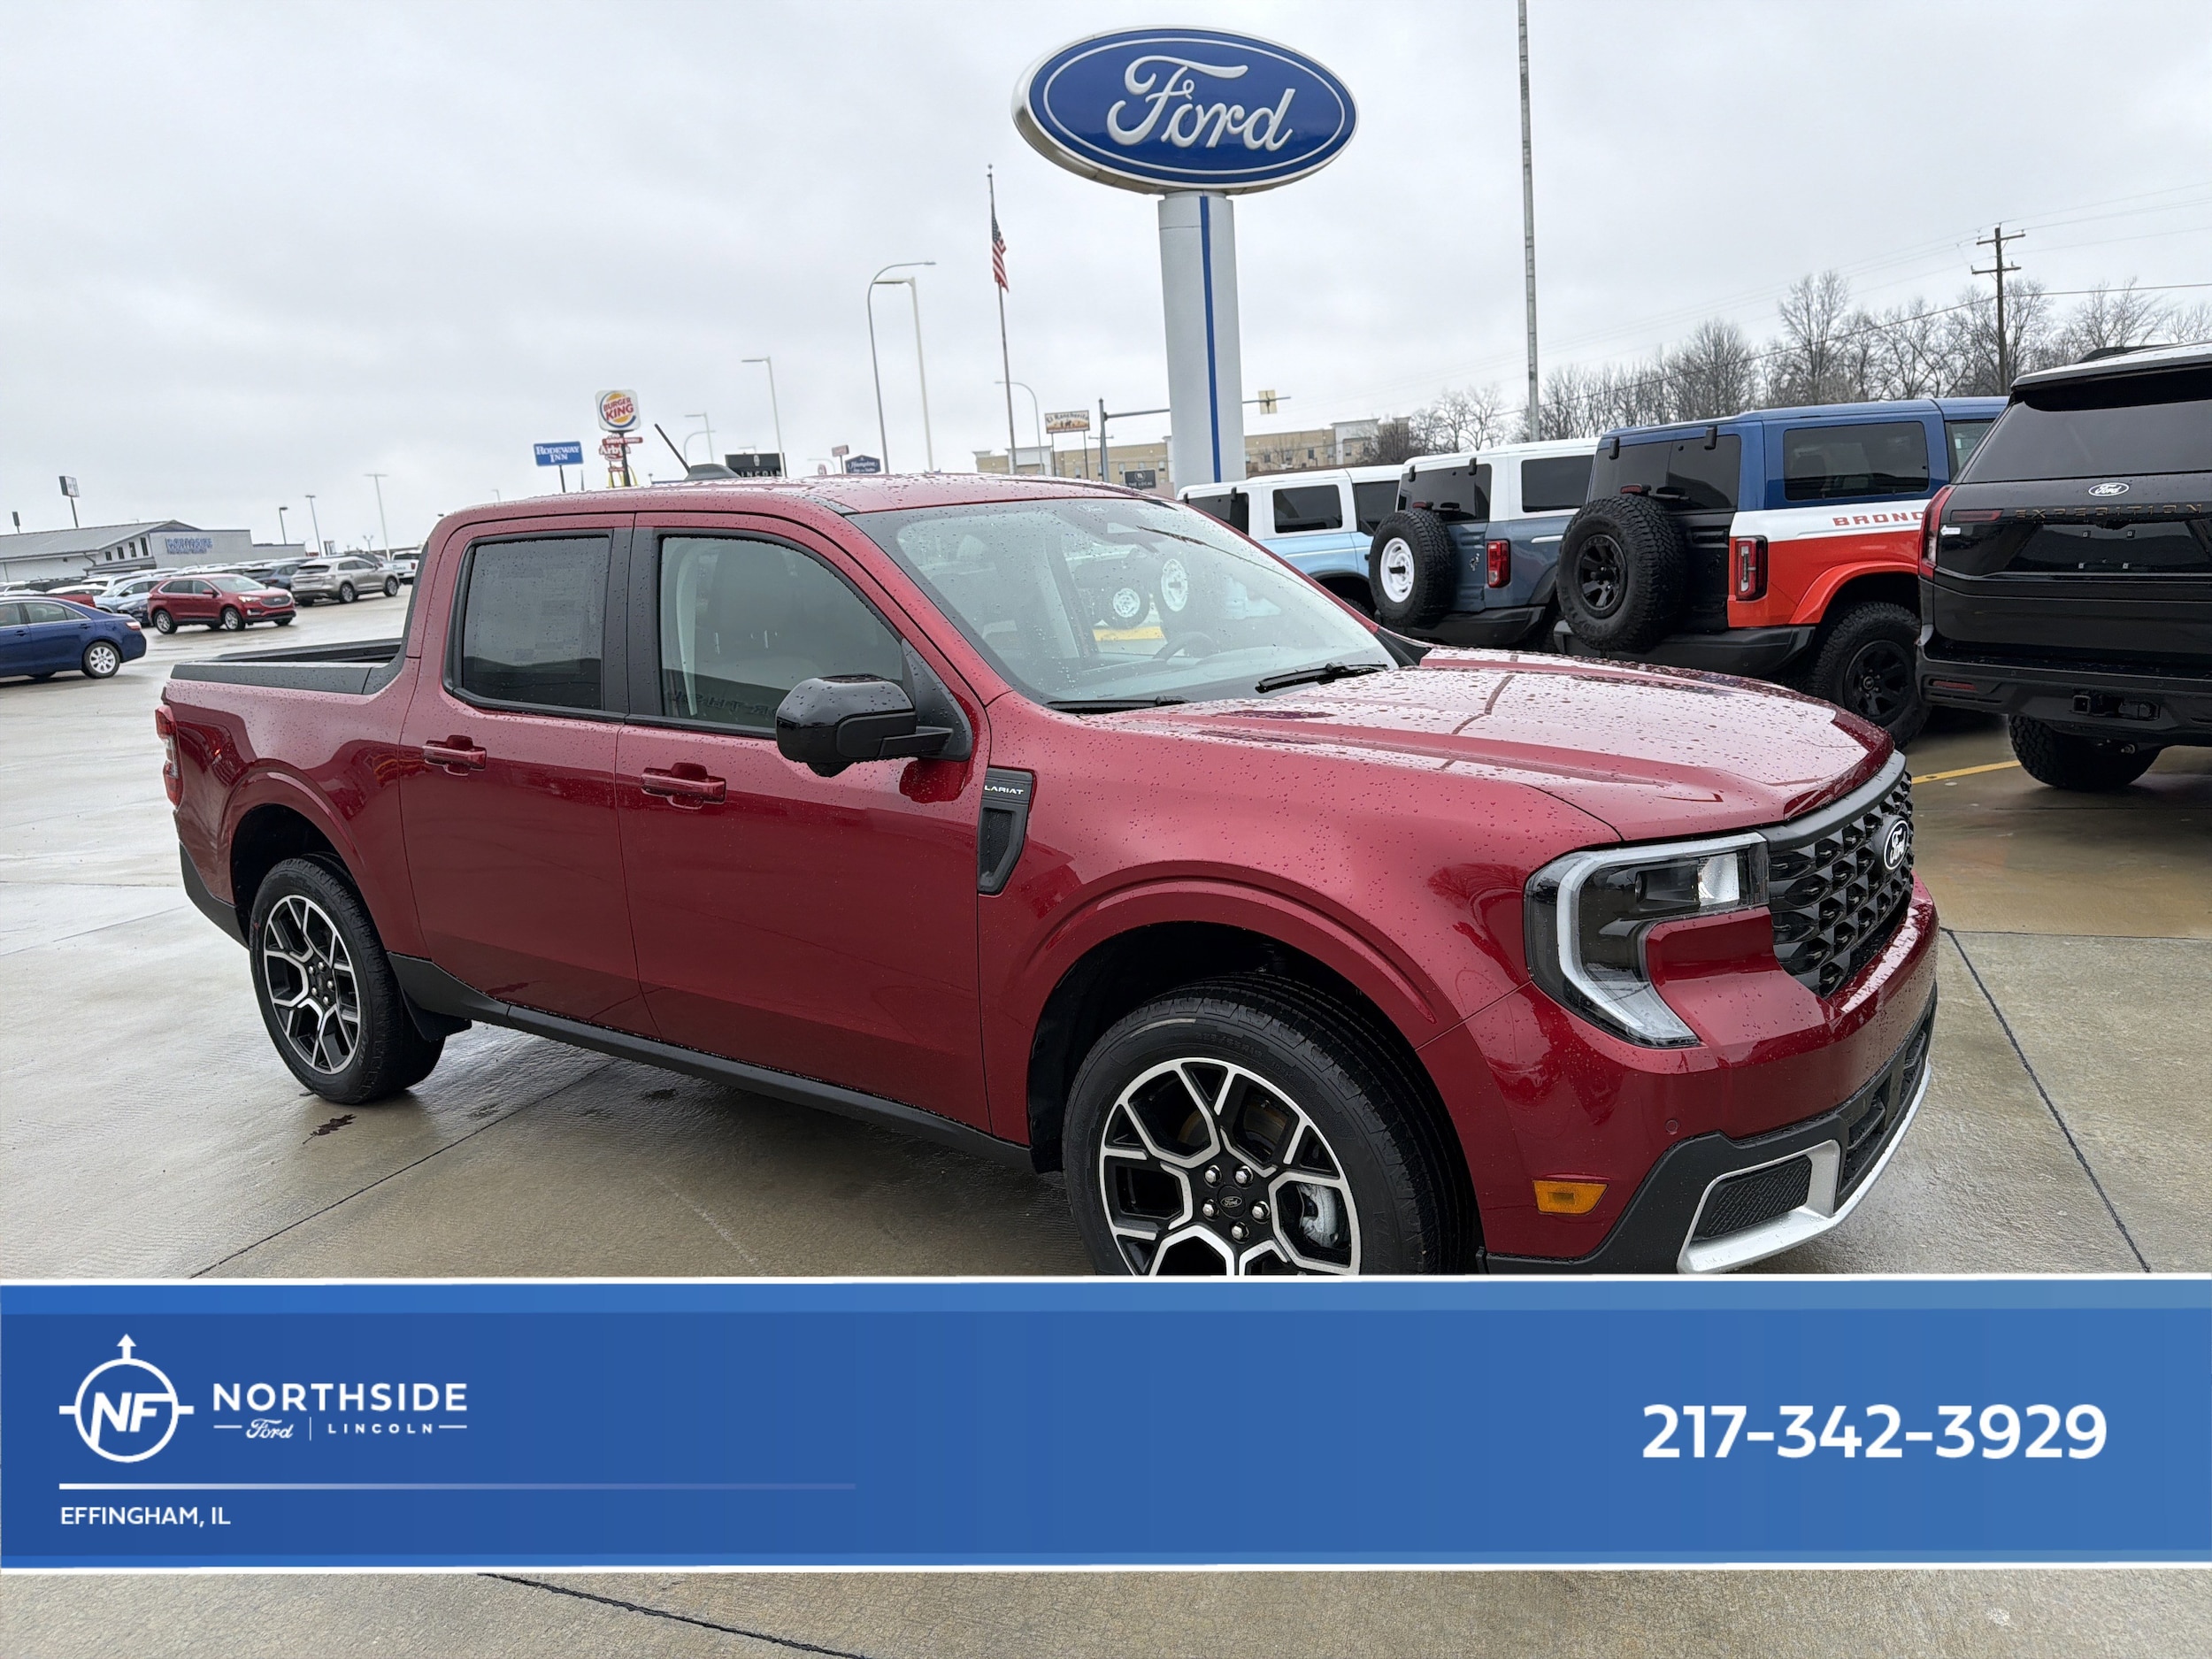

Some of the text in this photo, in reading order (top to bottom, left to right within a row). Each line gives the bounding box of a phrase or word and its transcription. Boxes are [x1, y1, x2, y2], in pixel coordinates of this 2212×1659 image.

[1106, 55, 1296, 151] Ford
[603, 397, 632, 411] BURGER
[605, 403, 634, 420] KING
[535, 446, 580, 455] RODEWAY
[549, 453, 568, 463] INN
[2094, 483, 2123, 495] Ford
[1832, 511, 1924, 526] BRONC
[2015, 503, 2202, 520] EXPEDITION
[984, 785, 1025, 795] LARIAT
